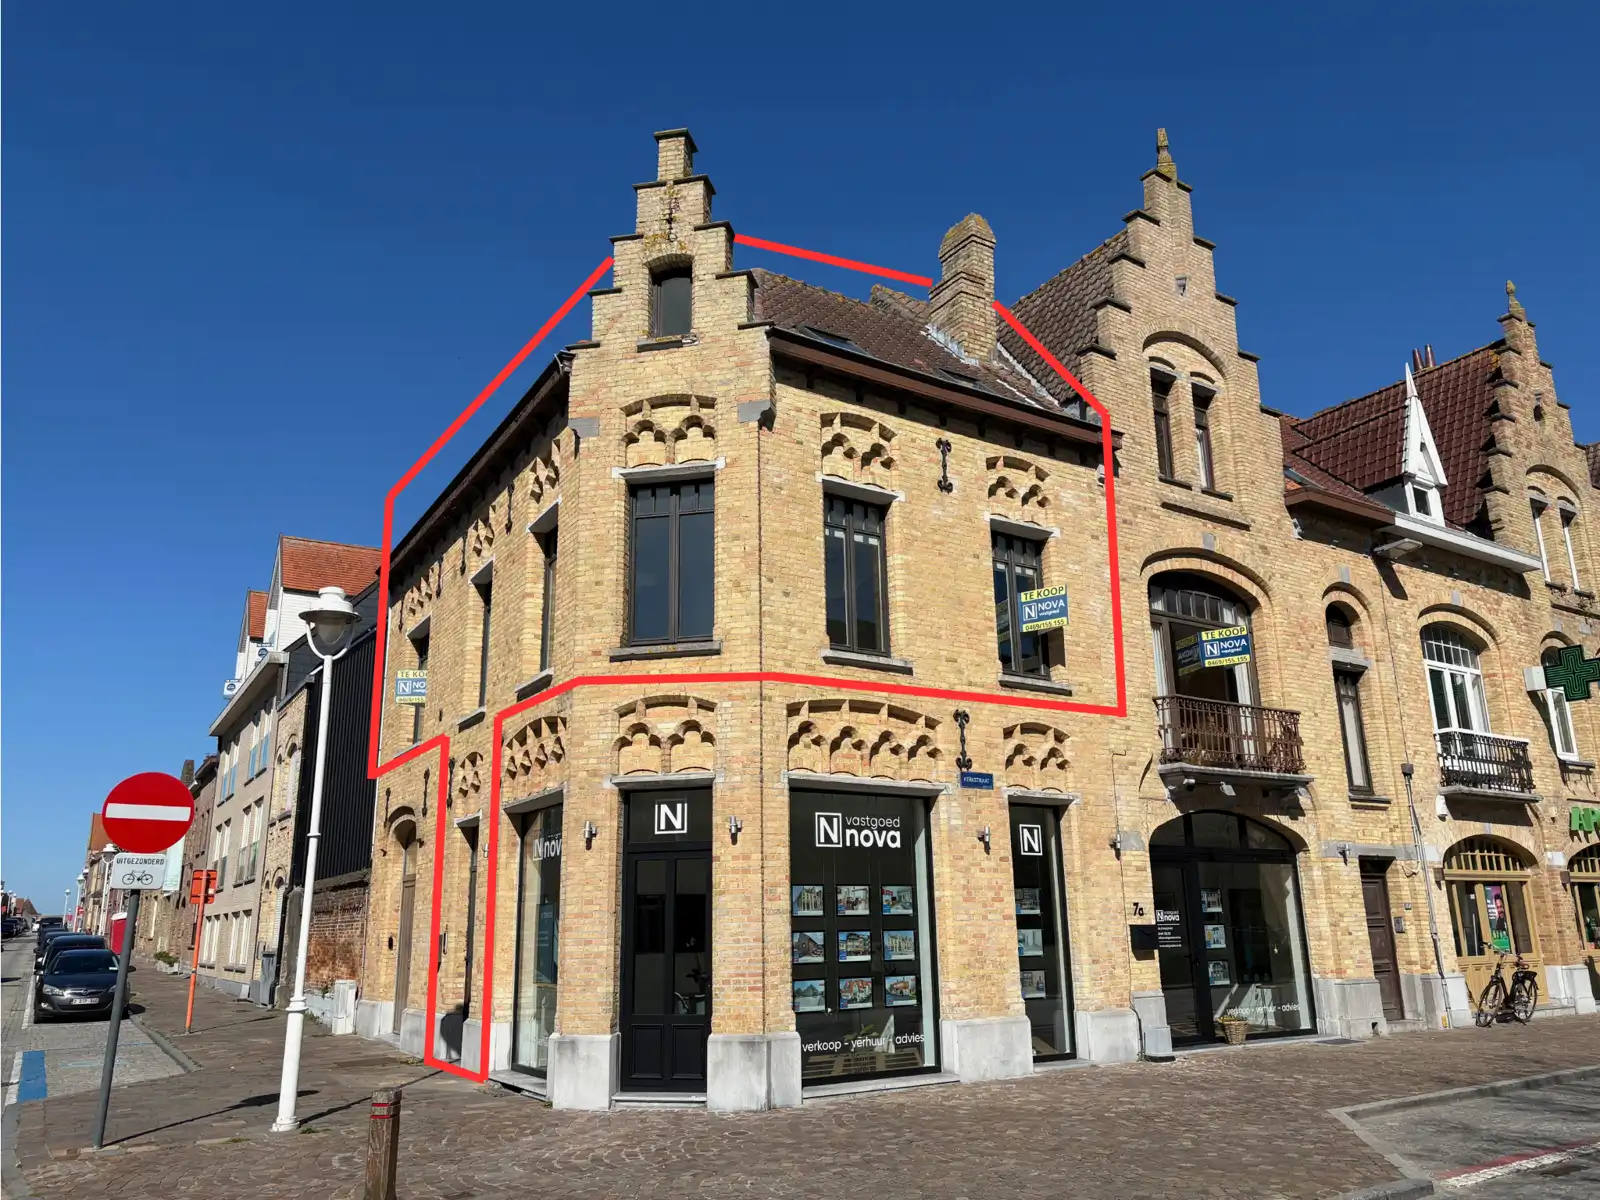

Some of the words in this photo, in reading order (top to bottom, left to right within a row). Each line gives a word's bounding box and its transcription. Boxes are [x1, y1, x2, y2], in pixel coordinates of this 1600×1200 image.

[1024, 592, 1034, 600] TE
[1036, 586, 1064, 598] KOOP
[1038, 599, 1065, 611] NOVA
[1205, 632, 1216, 640] TE
[1218, 627, 1246, 637] KOOP
[1220, 638, 1247, 649] NOVA
[412, 681, 426, 689] NO
[658, 802, 684, 831] N
[845, 815, 900, 829] vastgoed
[845, 828, 901, 848] nova
[544, 838, 562, 858] nov
[116, 857, 165, 865] UITGEZONDERD
[1133, 902, 1144, 916] 7a
[802, 1040, 842, 1052] verkoop
[851, 1036, 887, 1048] verhuur
[895, 1032, 925, 1045] advies
